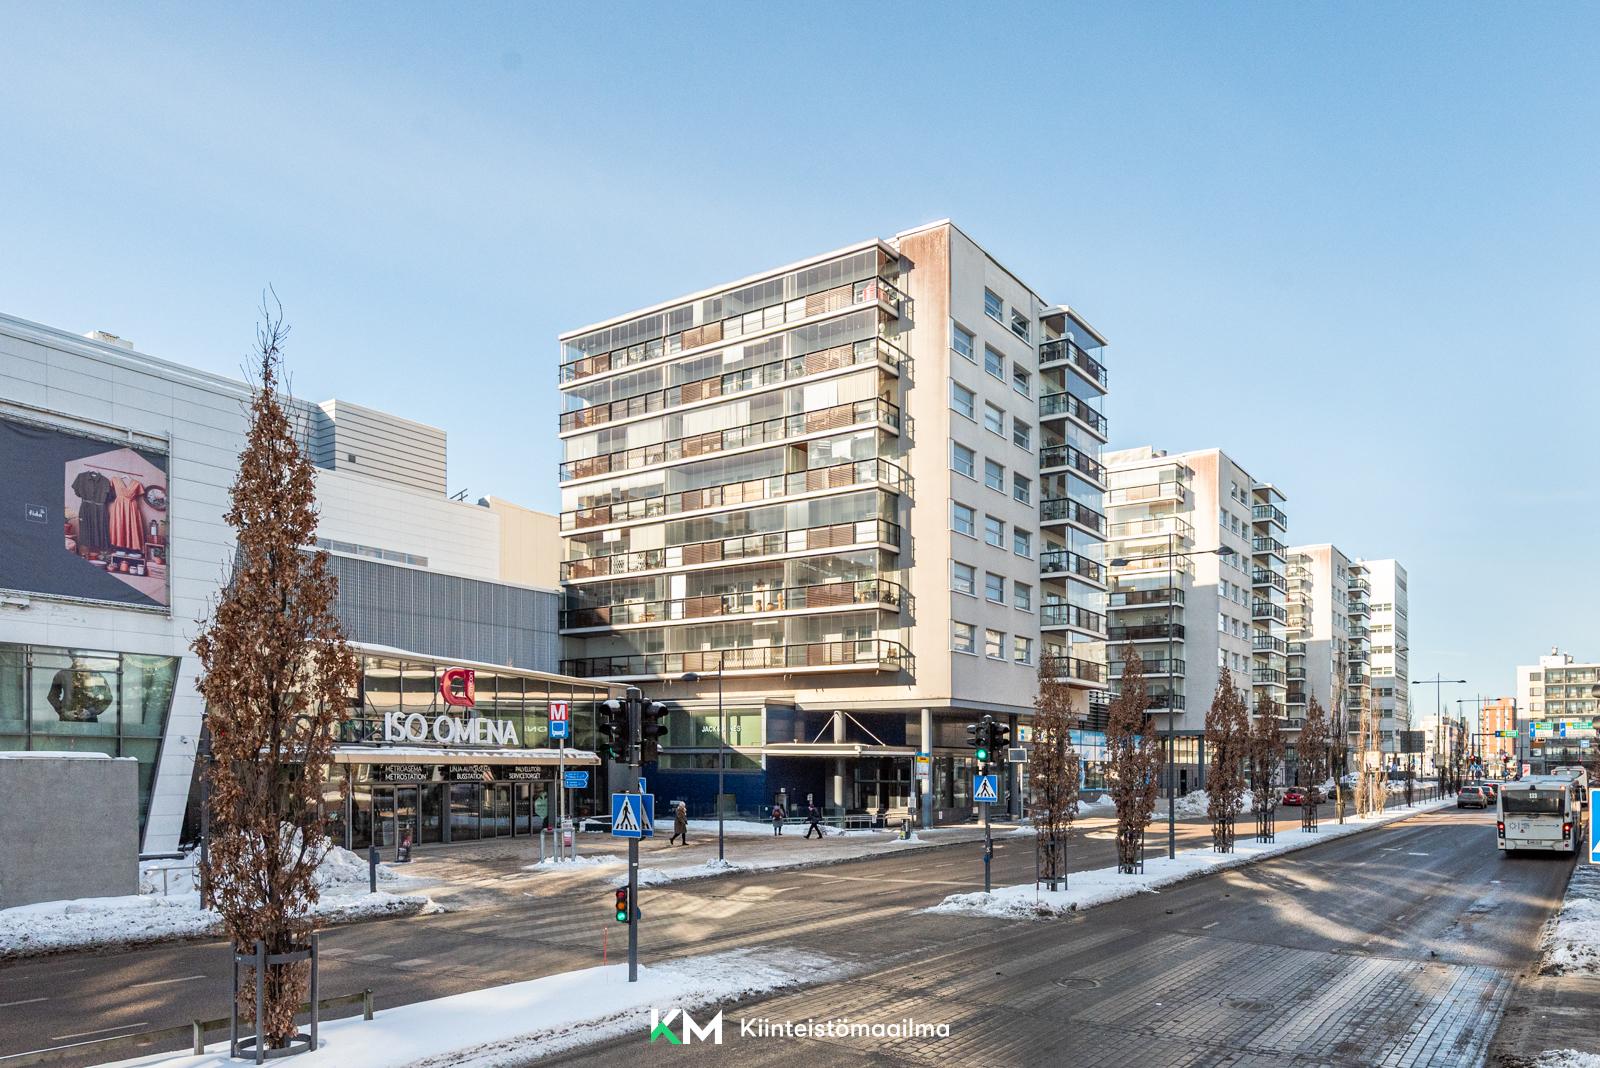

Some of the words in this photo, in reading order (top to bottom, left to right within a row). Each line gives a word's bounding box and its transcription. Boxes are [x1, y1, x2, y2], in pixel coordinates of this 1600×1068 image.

[550, 704, 565, 720] M
[384, 711, 428, 742] ISO
[433, 715, 519, 745] OMENA
[385, 765, 423, 773] METROASEMA
[385, 773, 427, 781] METROSTATION
